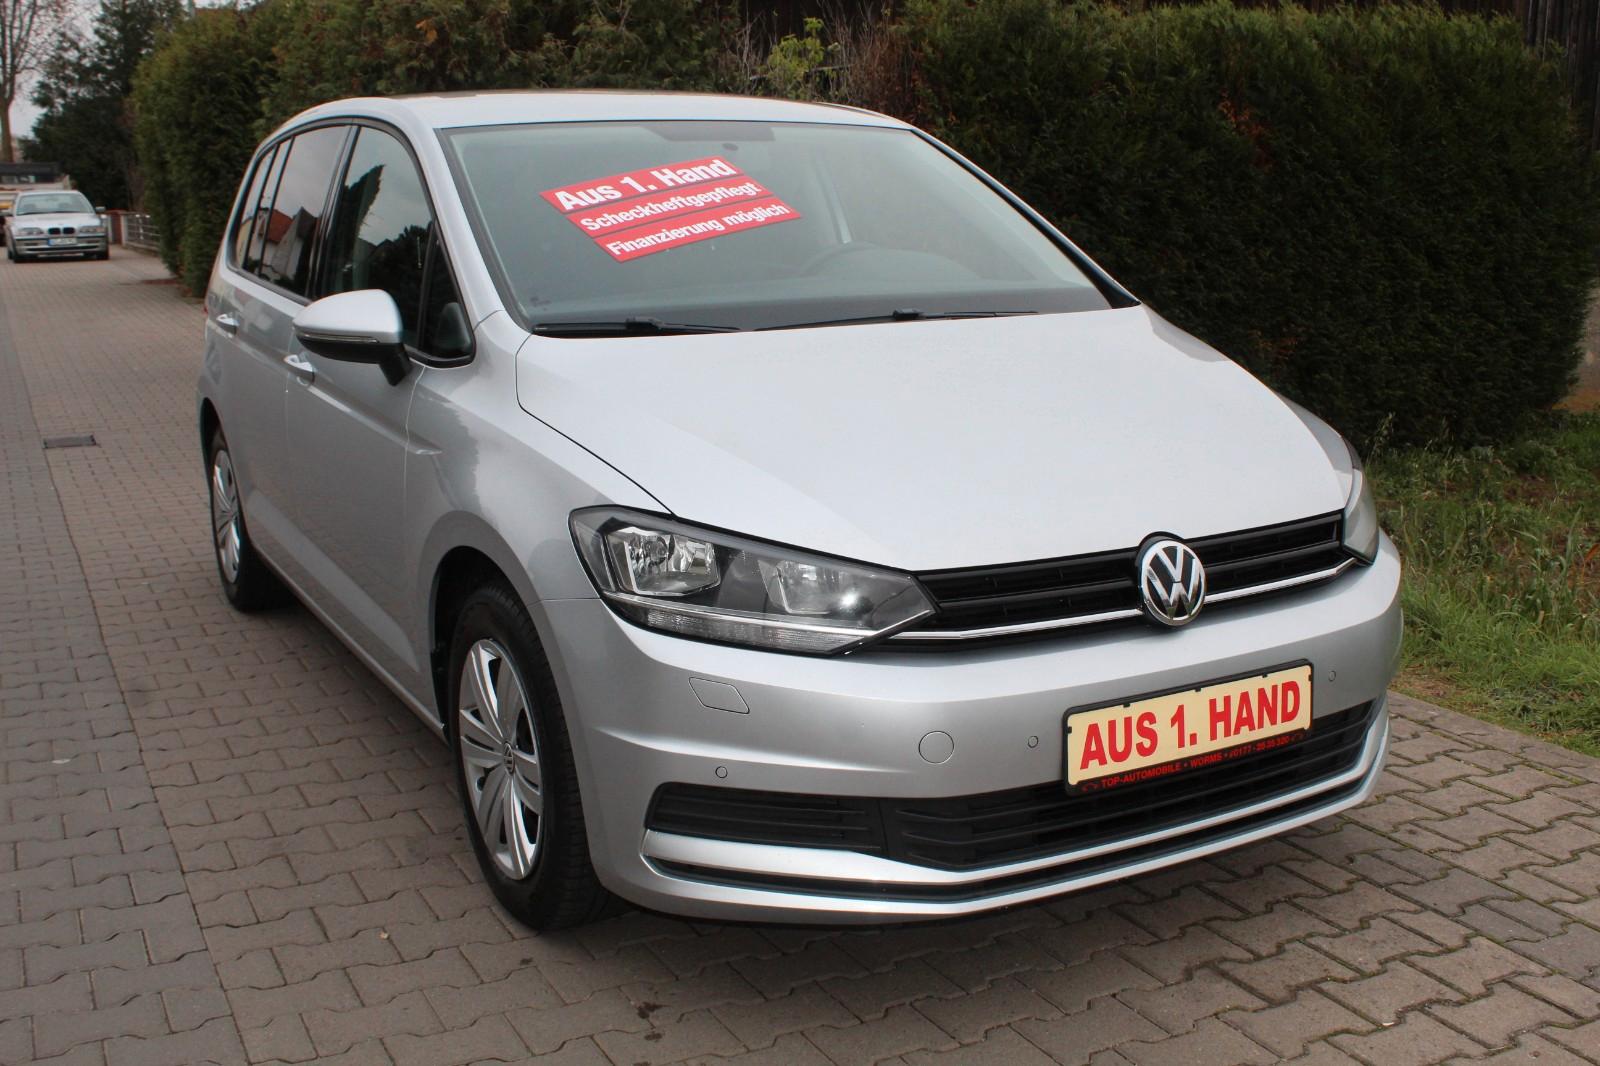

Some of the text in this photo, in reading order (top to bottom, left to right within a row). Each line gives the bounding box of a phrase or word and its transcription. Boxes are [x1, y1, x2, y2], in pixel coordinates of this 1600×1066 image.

[554, 159, 737, 210] Aus 1. Hand
[580, 182, 763, 232] Scheckheftgepflegt
[606, 203, 790, 256] Finanzierung möglich
[1079, 680, 1301, 770] AUS 1. HAND
[1101, 762, 1182, 789] TOP-AUTOMOBILE
[1190, 752, 1223, 769] WORMS
